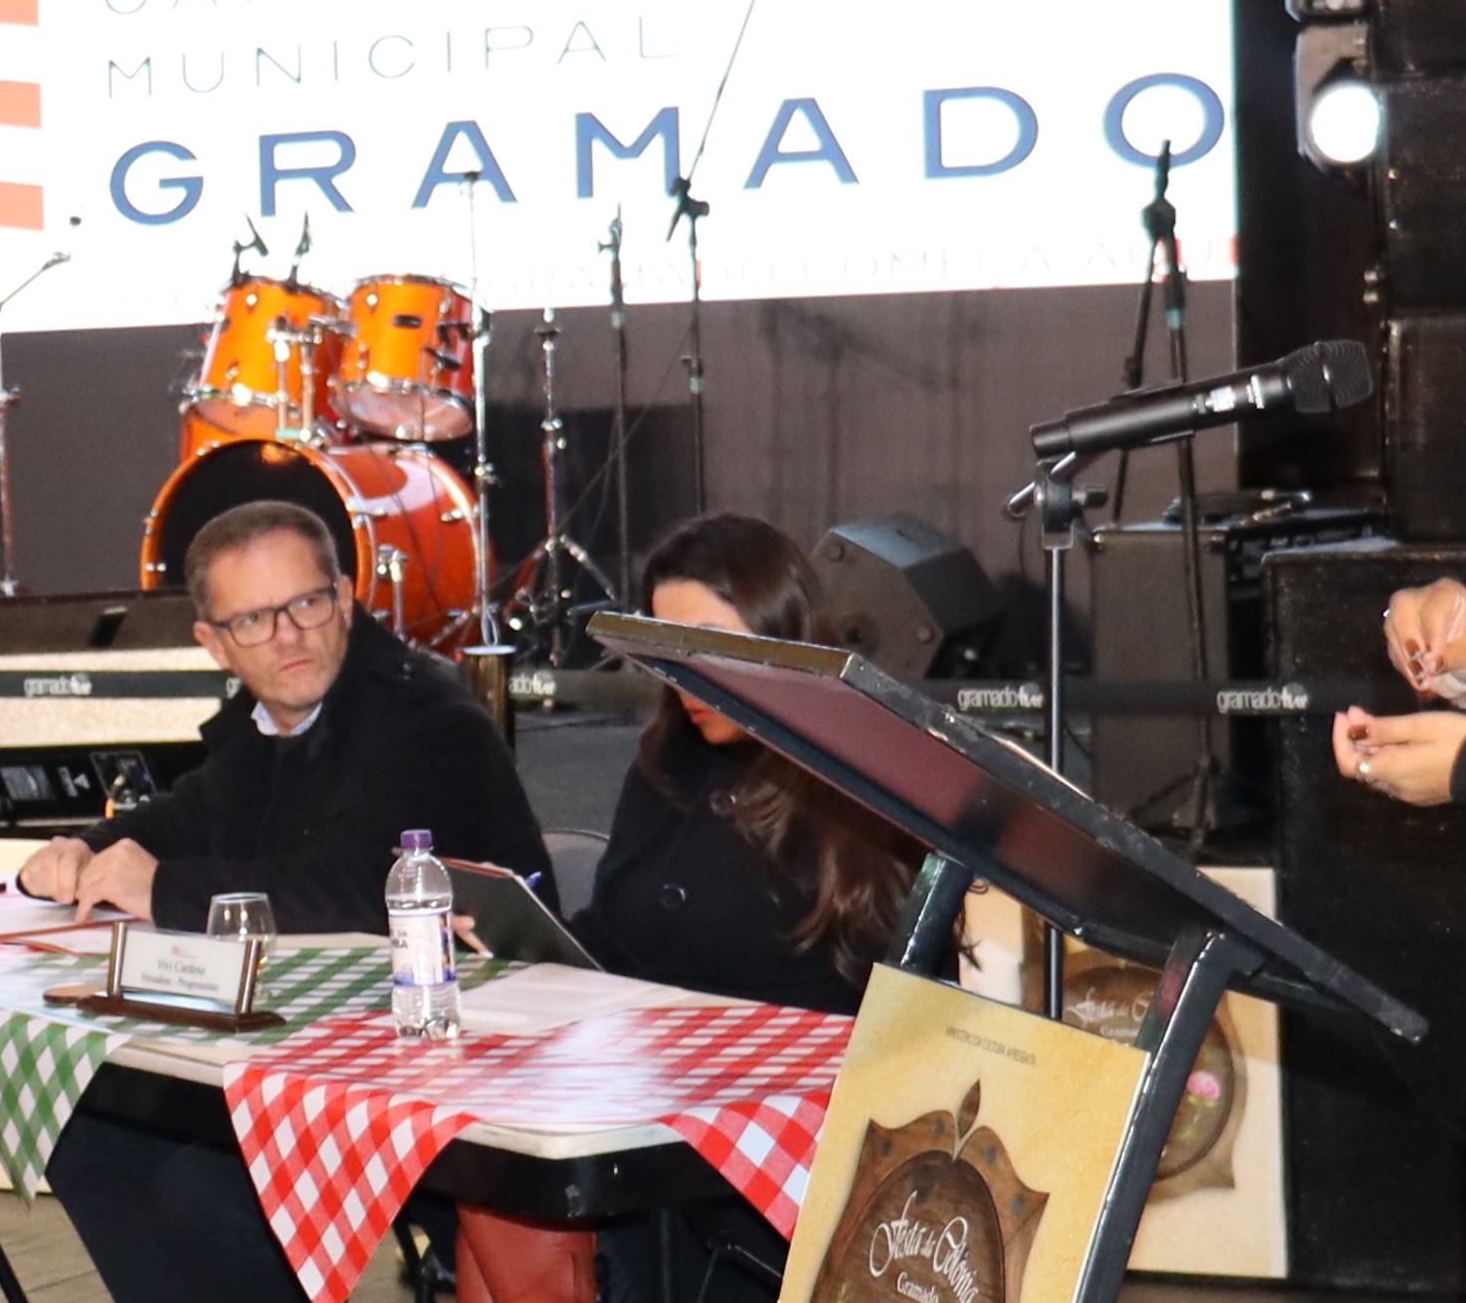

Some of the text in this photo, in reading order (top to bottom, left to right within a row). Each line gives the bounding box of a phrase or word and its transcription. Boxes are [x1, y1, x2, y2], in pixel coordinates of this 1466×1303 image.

[108, 16, 679, 100] MUNICIPAL
[109, 72, 1226, 226] GRAMADO
[870, 1190, 926, 1278] Festa
